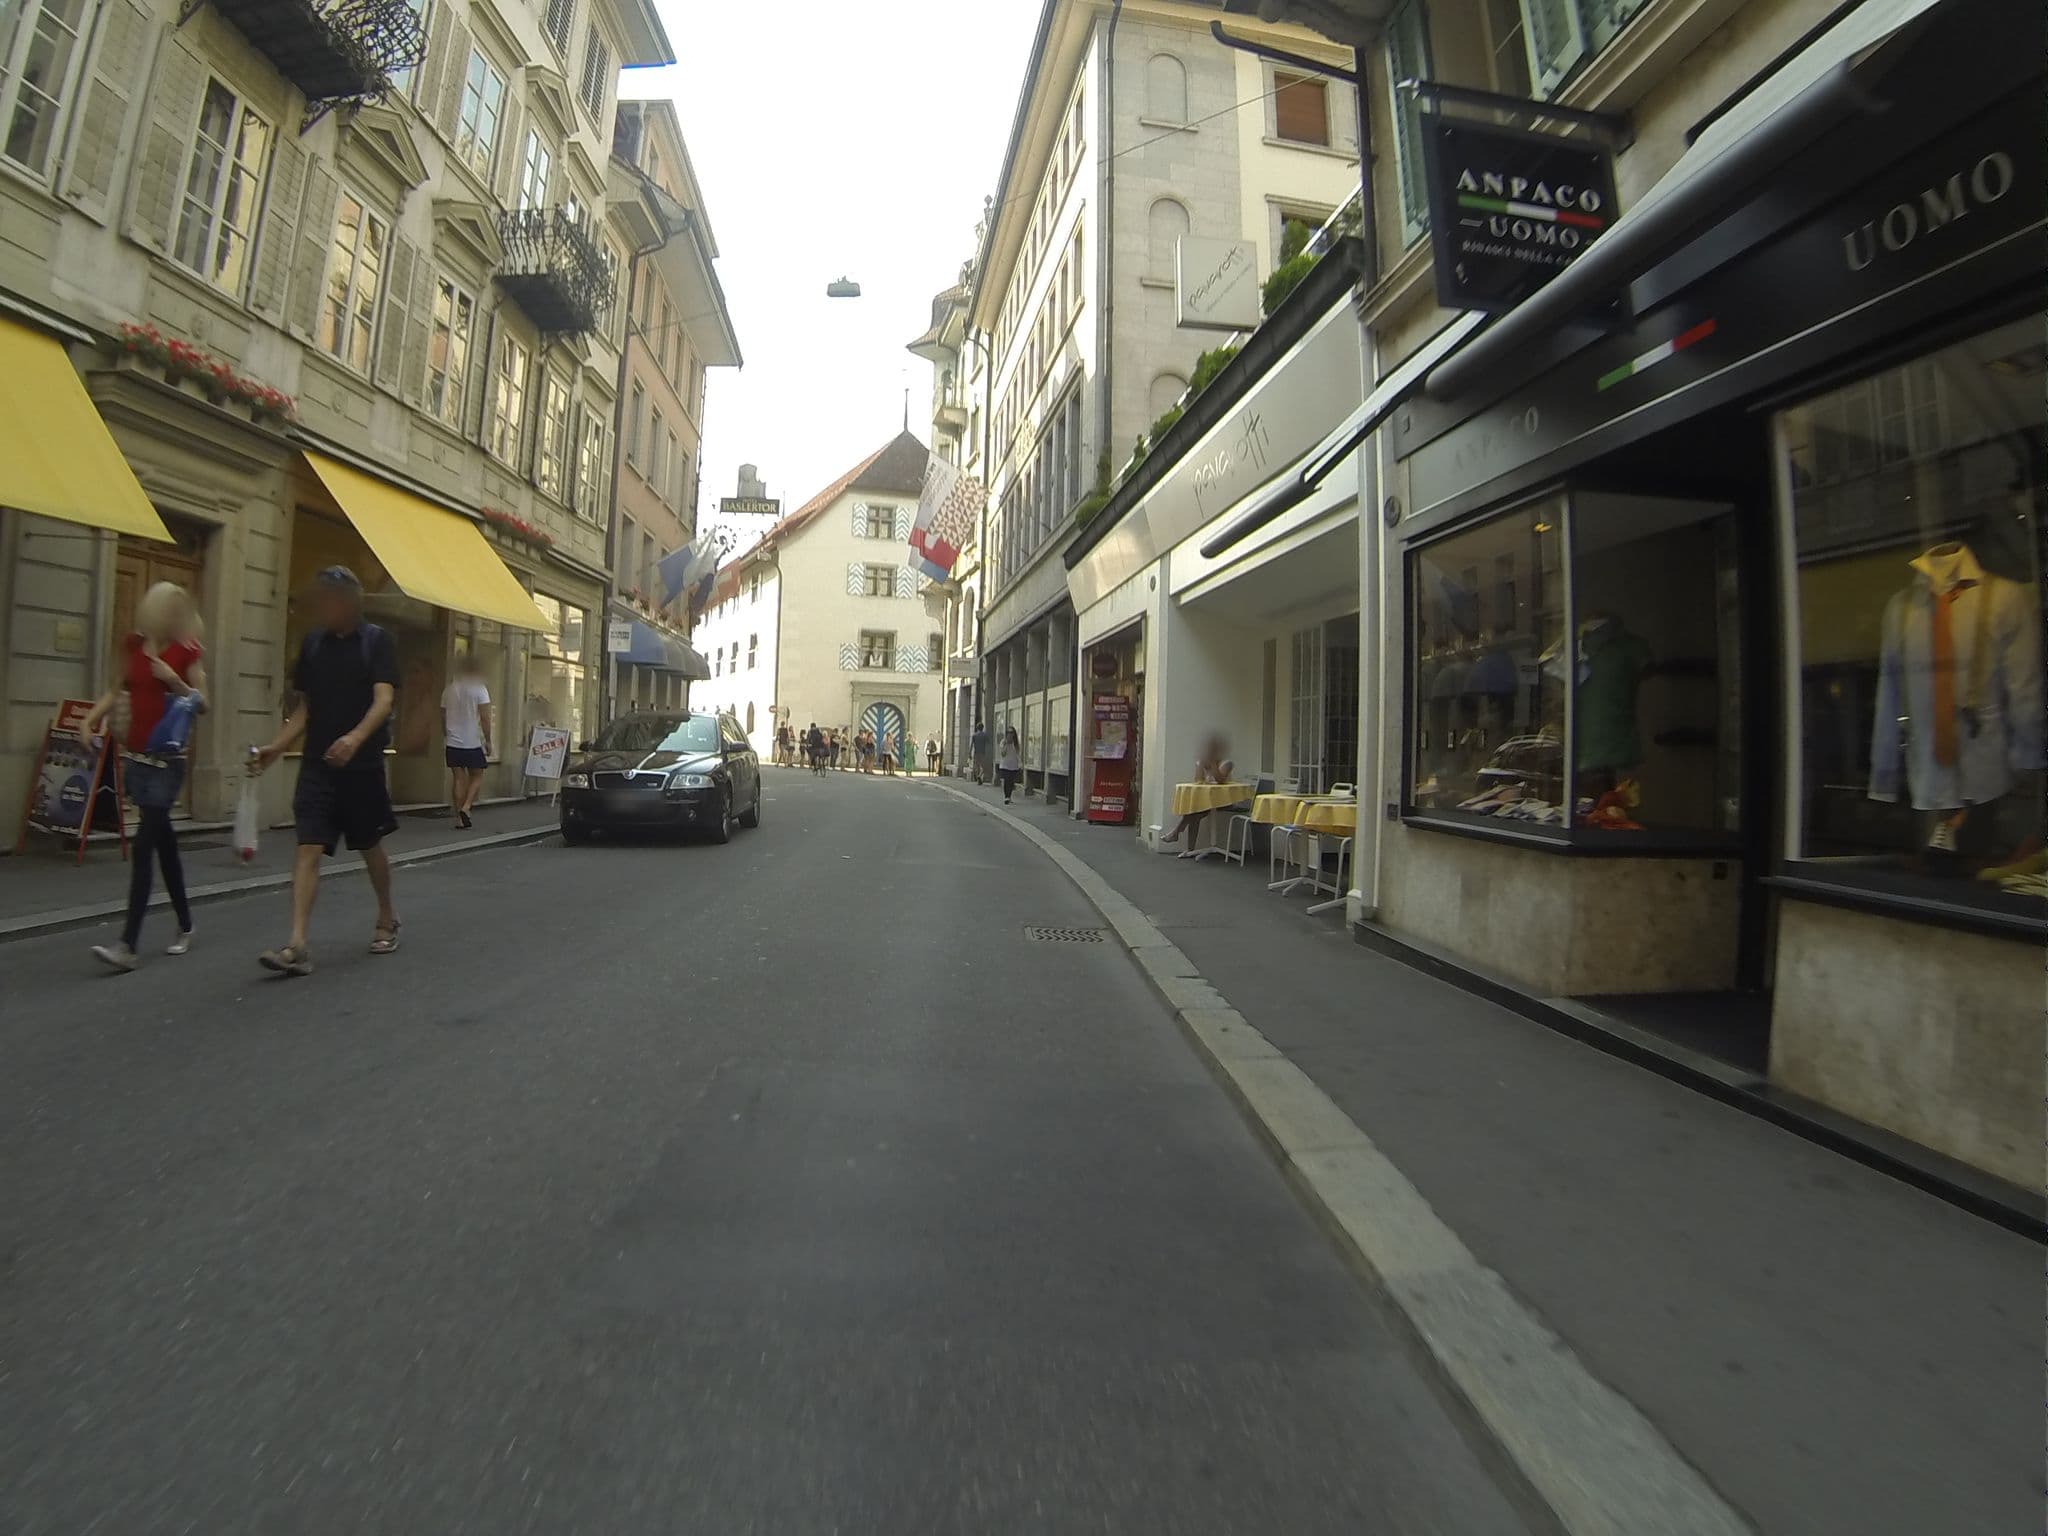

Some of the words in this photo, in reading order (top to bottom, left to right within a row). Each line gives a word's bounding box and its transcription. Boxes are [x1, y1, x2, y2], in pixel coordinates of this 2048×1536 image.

[1456, 167, 1601, 212] ANPACO
[1841, 151, 2015, 271] UOMO
[1488, 215, 1581, 249] UOMO
